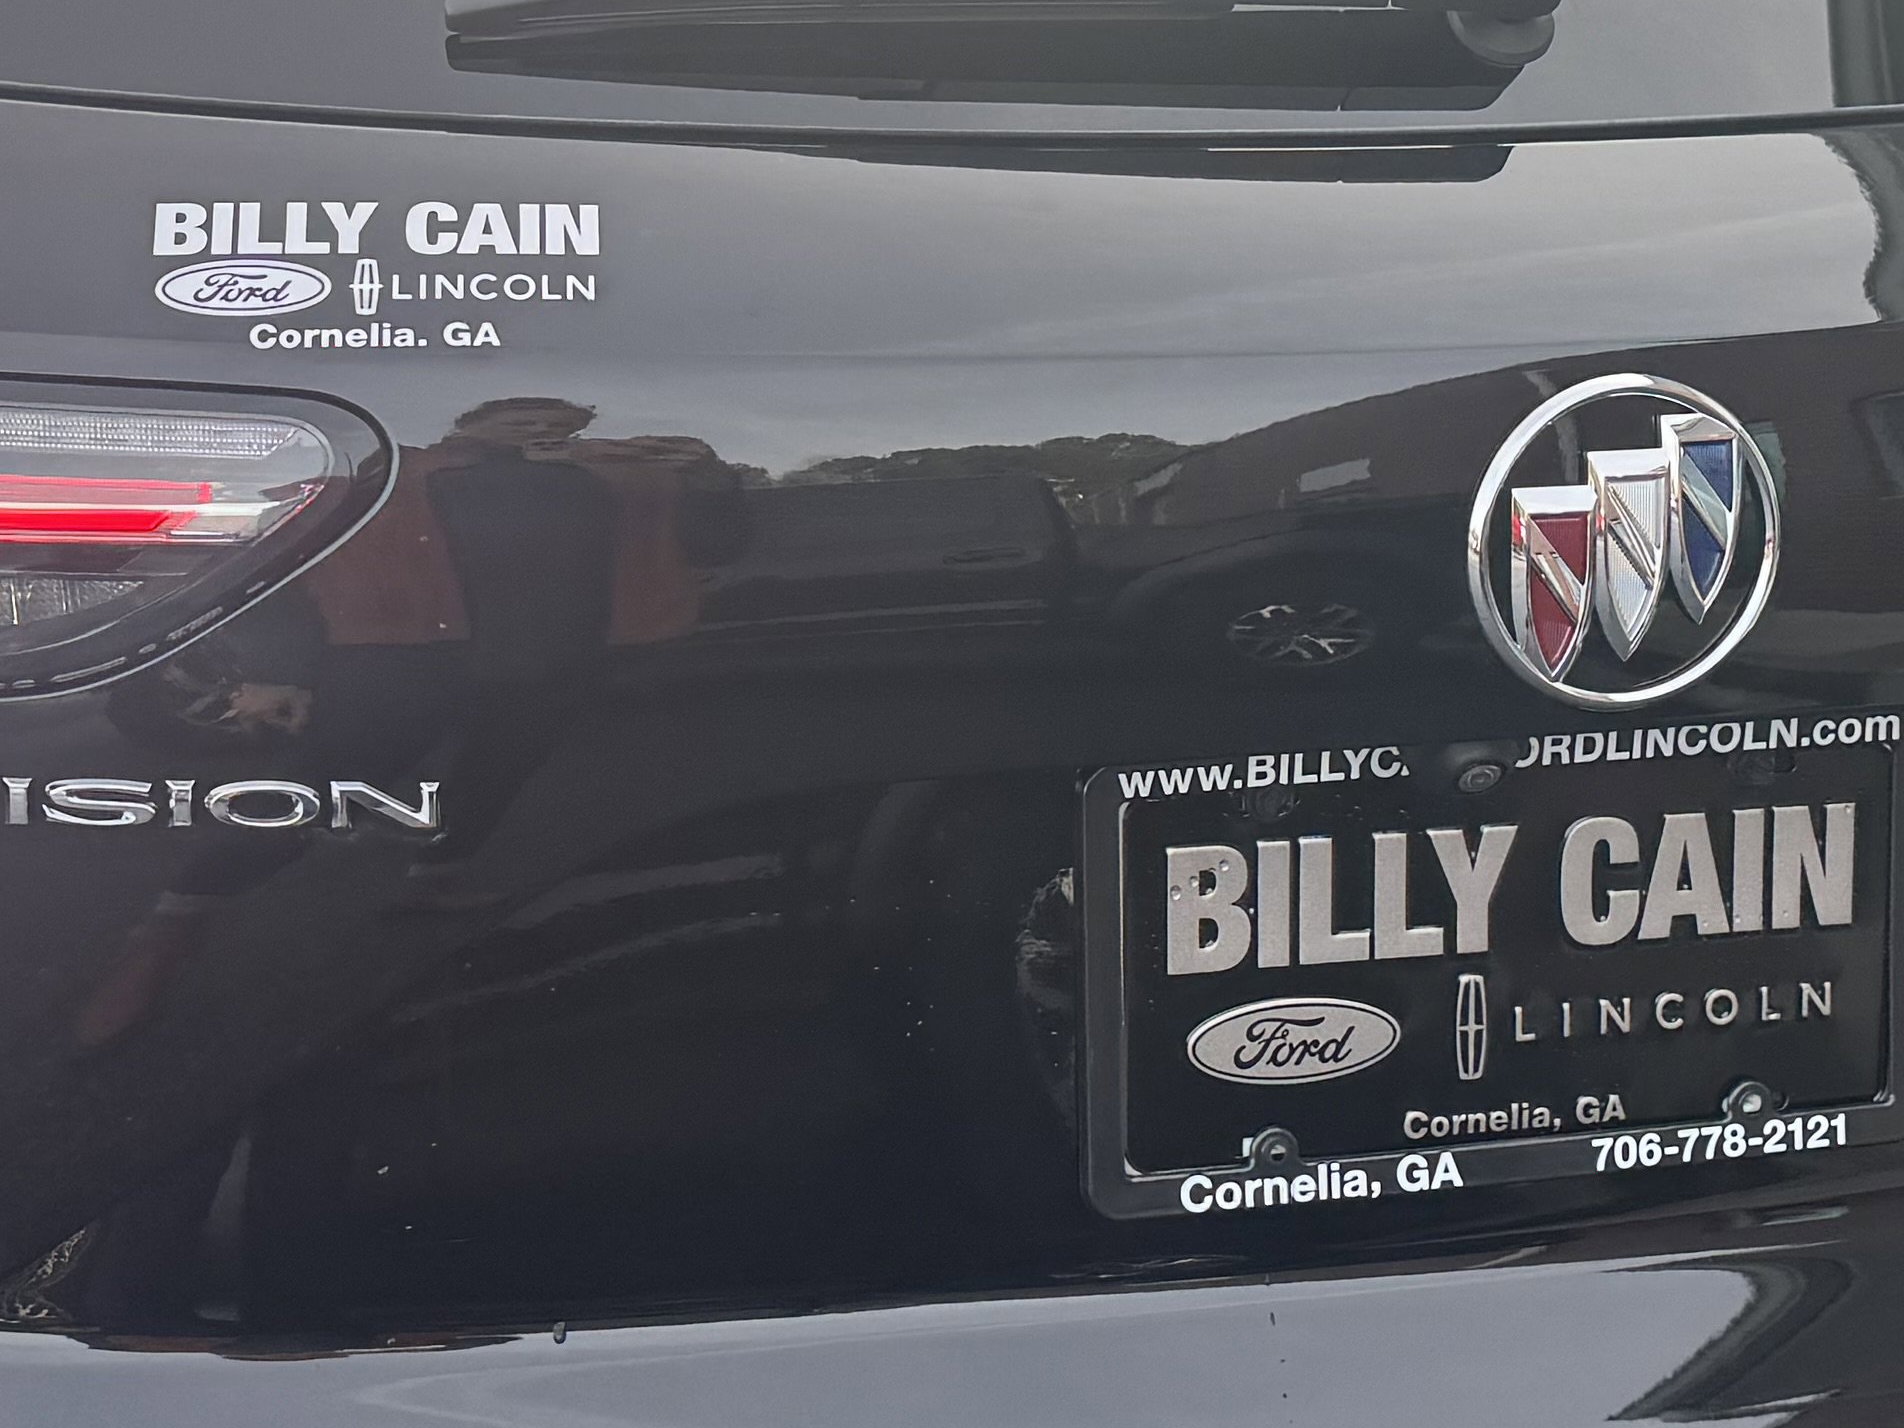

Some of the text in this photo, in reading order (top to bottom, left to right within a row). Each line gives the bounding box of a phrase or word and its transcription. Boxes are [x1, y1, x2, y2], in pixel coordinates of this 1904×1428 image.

[153, 201, 600, 256] BILLY CAIN
[193, 273, 596, 303] Ford LINCOLN
[443, 321, 501, 347] GA
[1166, 802, 1856, 976] BILLY CAIN
[1232, 981, 1832, 1071] Ford LINCOLN
[1403, 1094, 1627, 1140] Cornelia, GA
[1180, 1113, 1847, 1214] Cornelia, GA 706-778-2121
